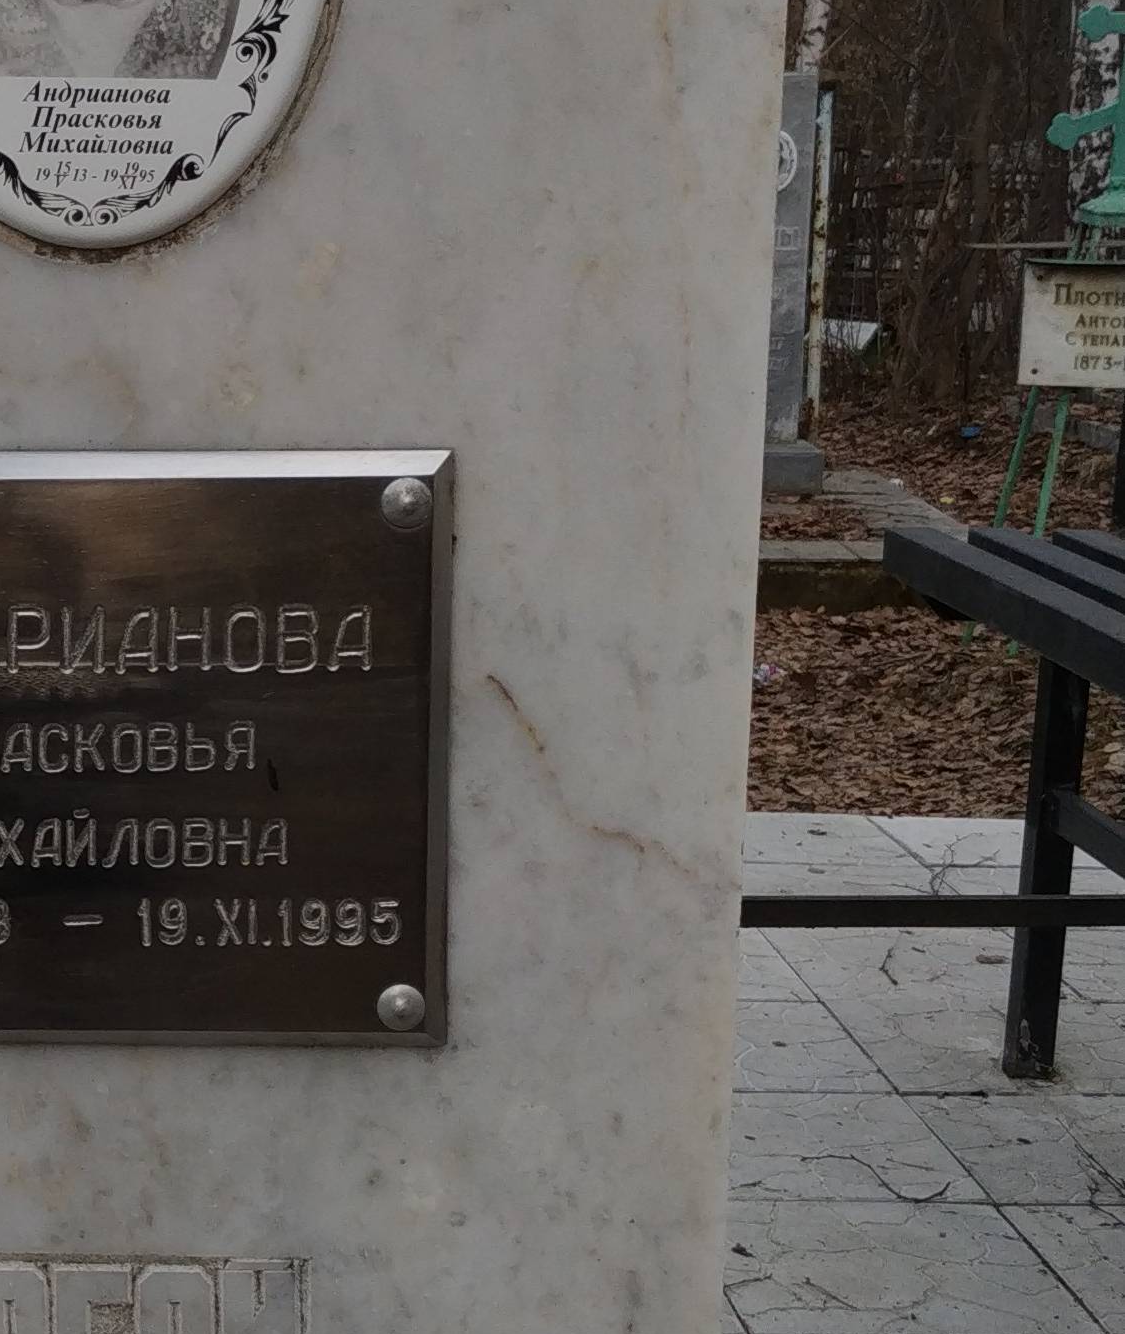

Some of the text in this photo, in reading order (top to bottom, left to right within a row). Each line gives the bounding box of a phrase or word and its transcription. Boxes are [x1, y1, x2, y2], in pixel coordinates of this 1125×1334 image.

[22, 80, 171, 107] Андрианова
[31, 106, 163, 133] Прасковья
[18, 131, 175, 155] Михайловна
